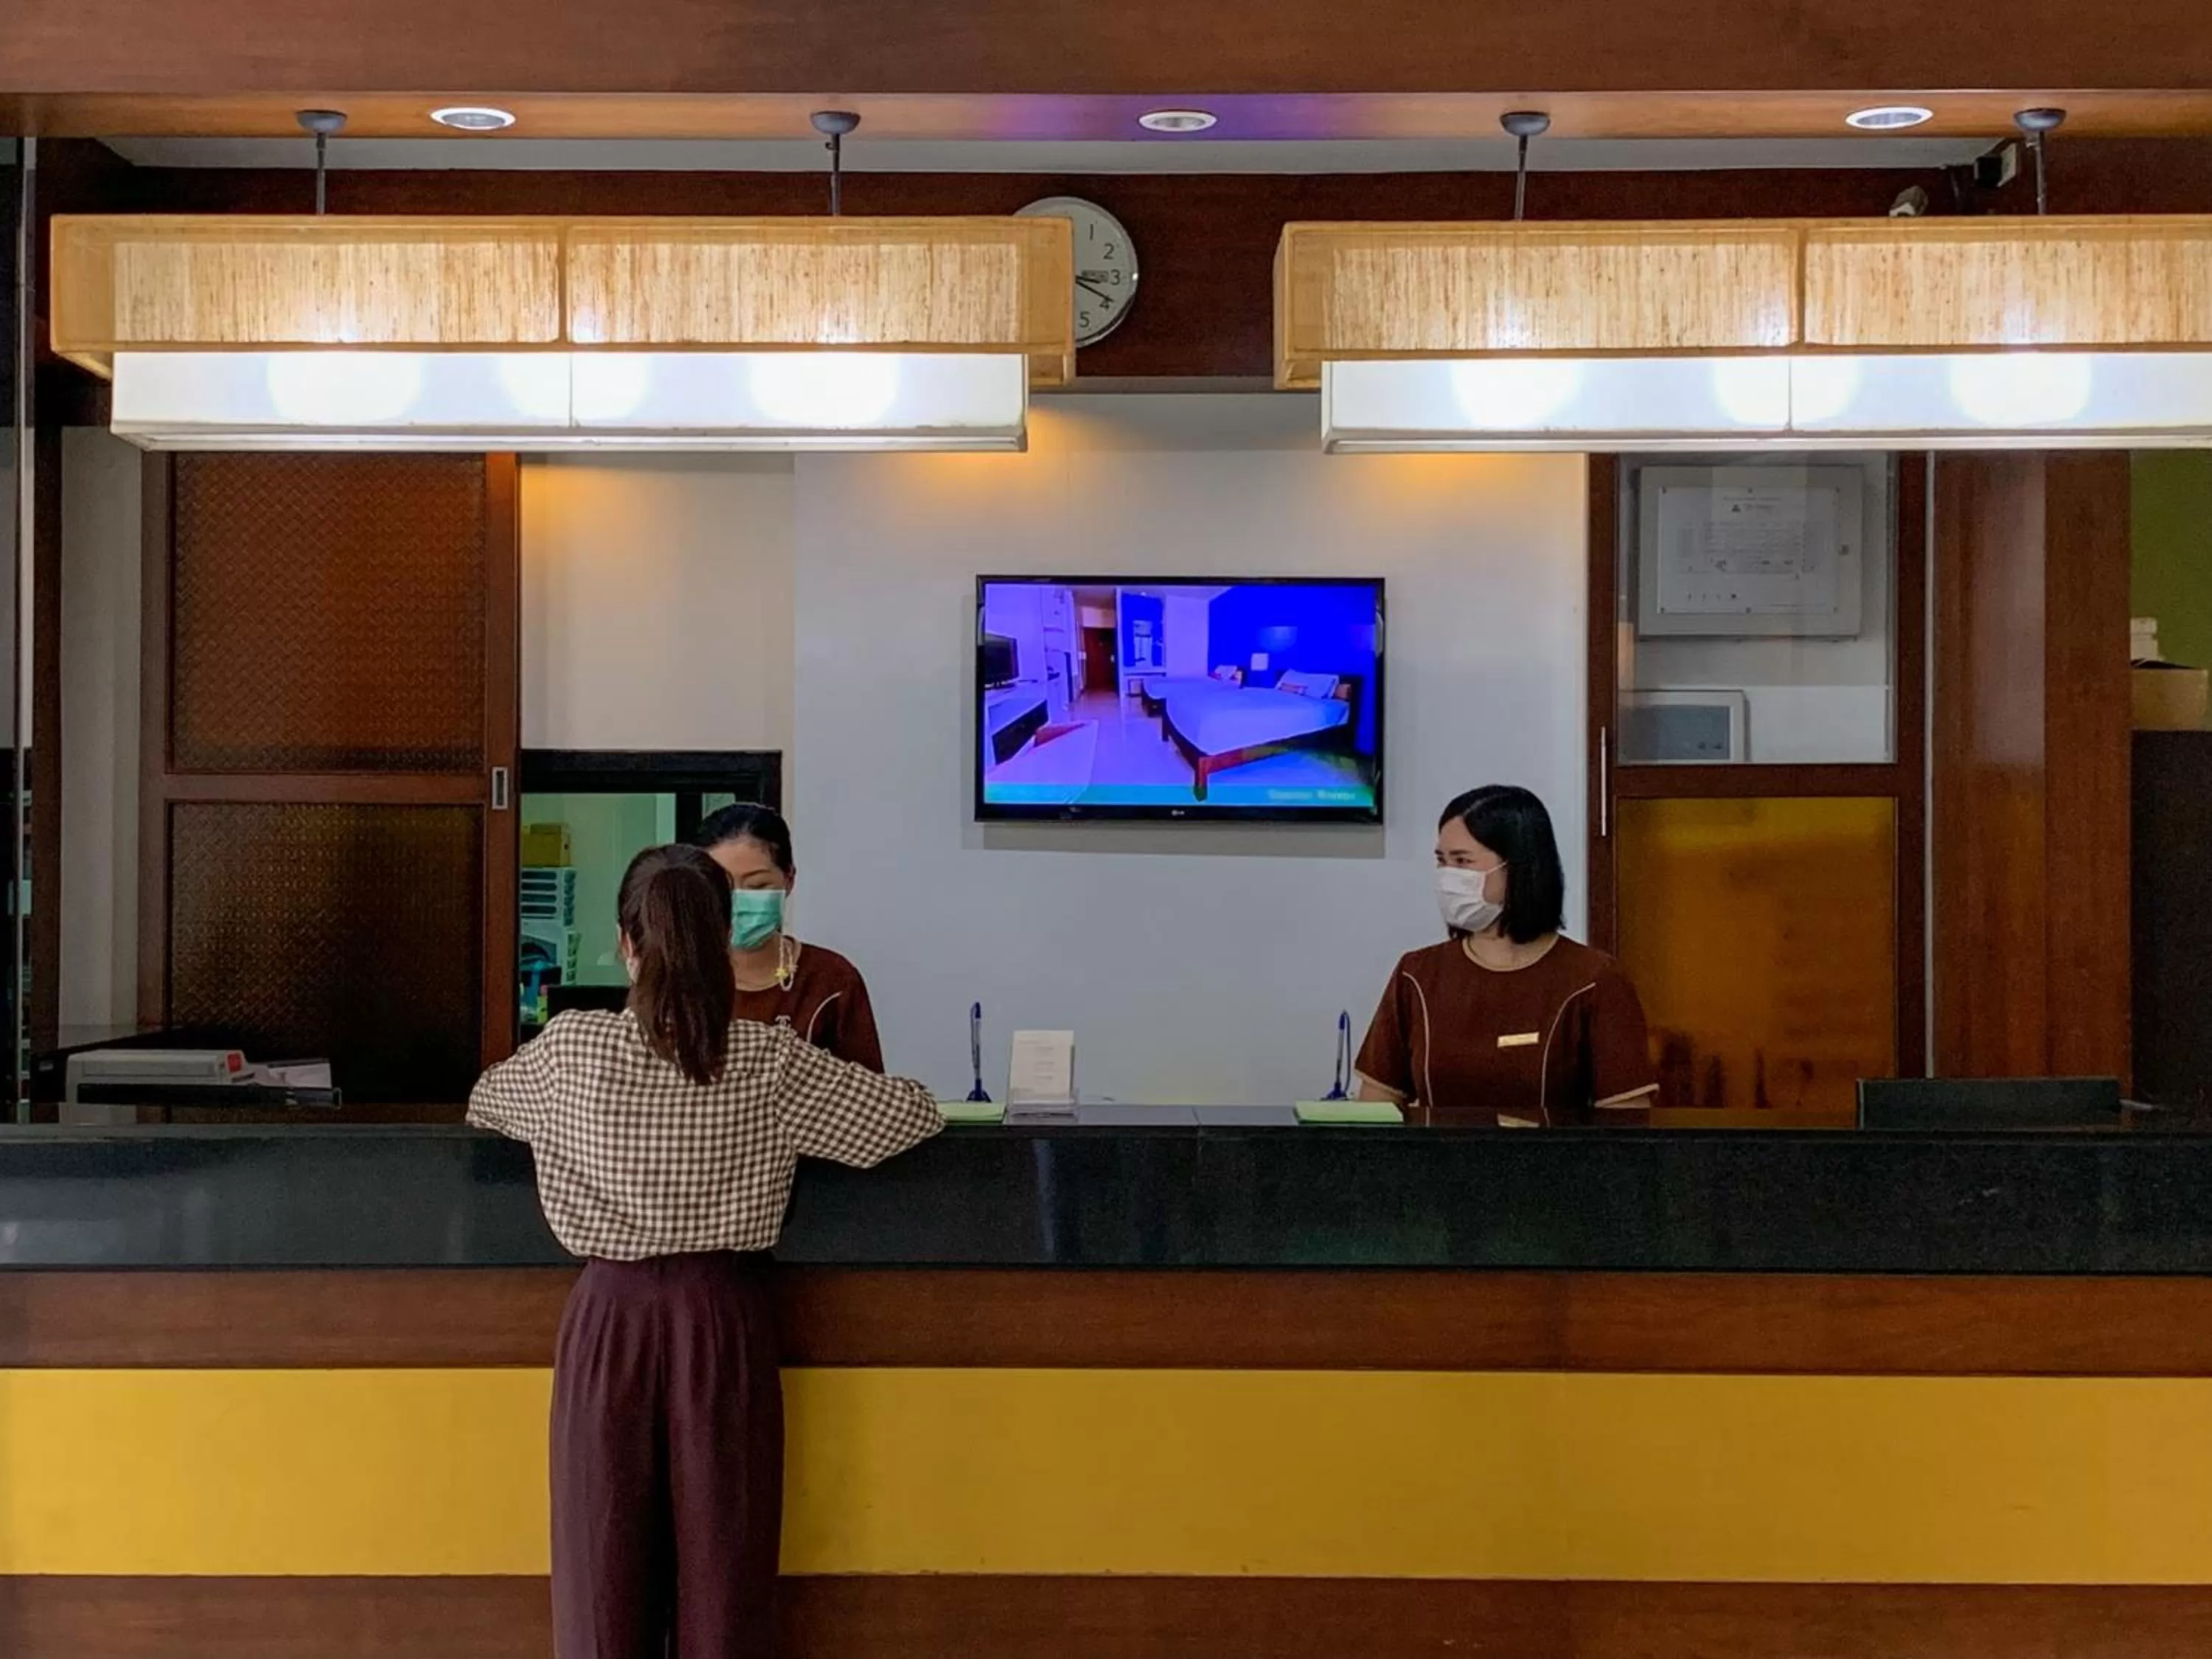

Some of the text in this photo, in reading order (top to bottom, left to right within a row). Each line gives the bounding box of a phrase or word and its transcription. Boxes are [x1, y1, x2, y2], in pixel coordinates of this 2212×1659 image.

[1089, 223, 1094, 240] 1
[1104, 243, 1114, 260] 2
[1110, 269, 1121, 285] 3
[1079, 311, 1090, 328] 5
